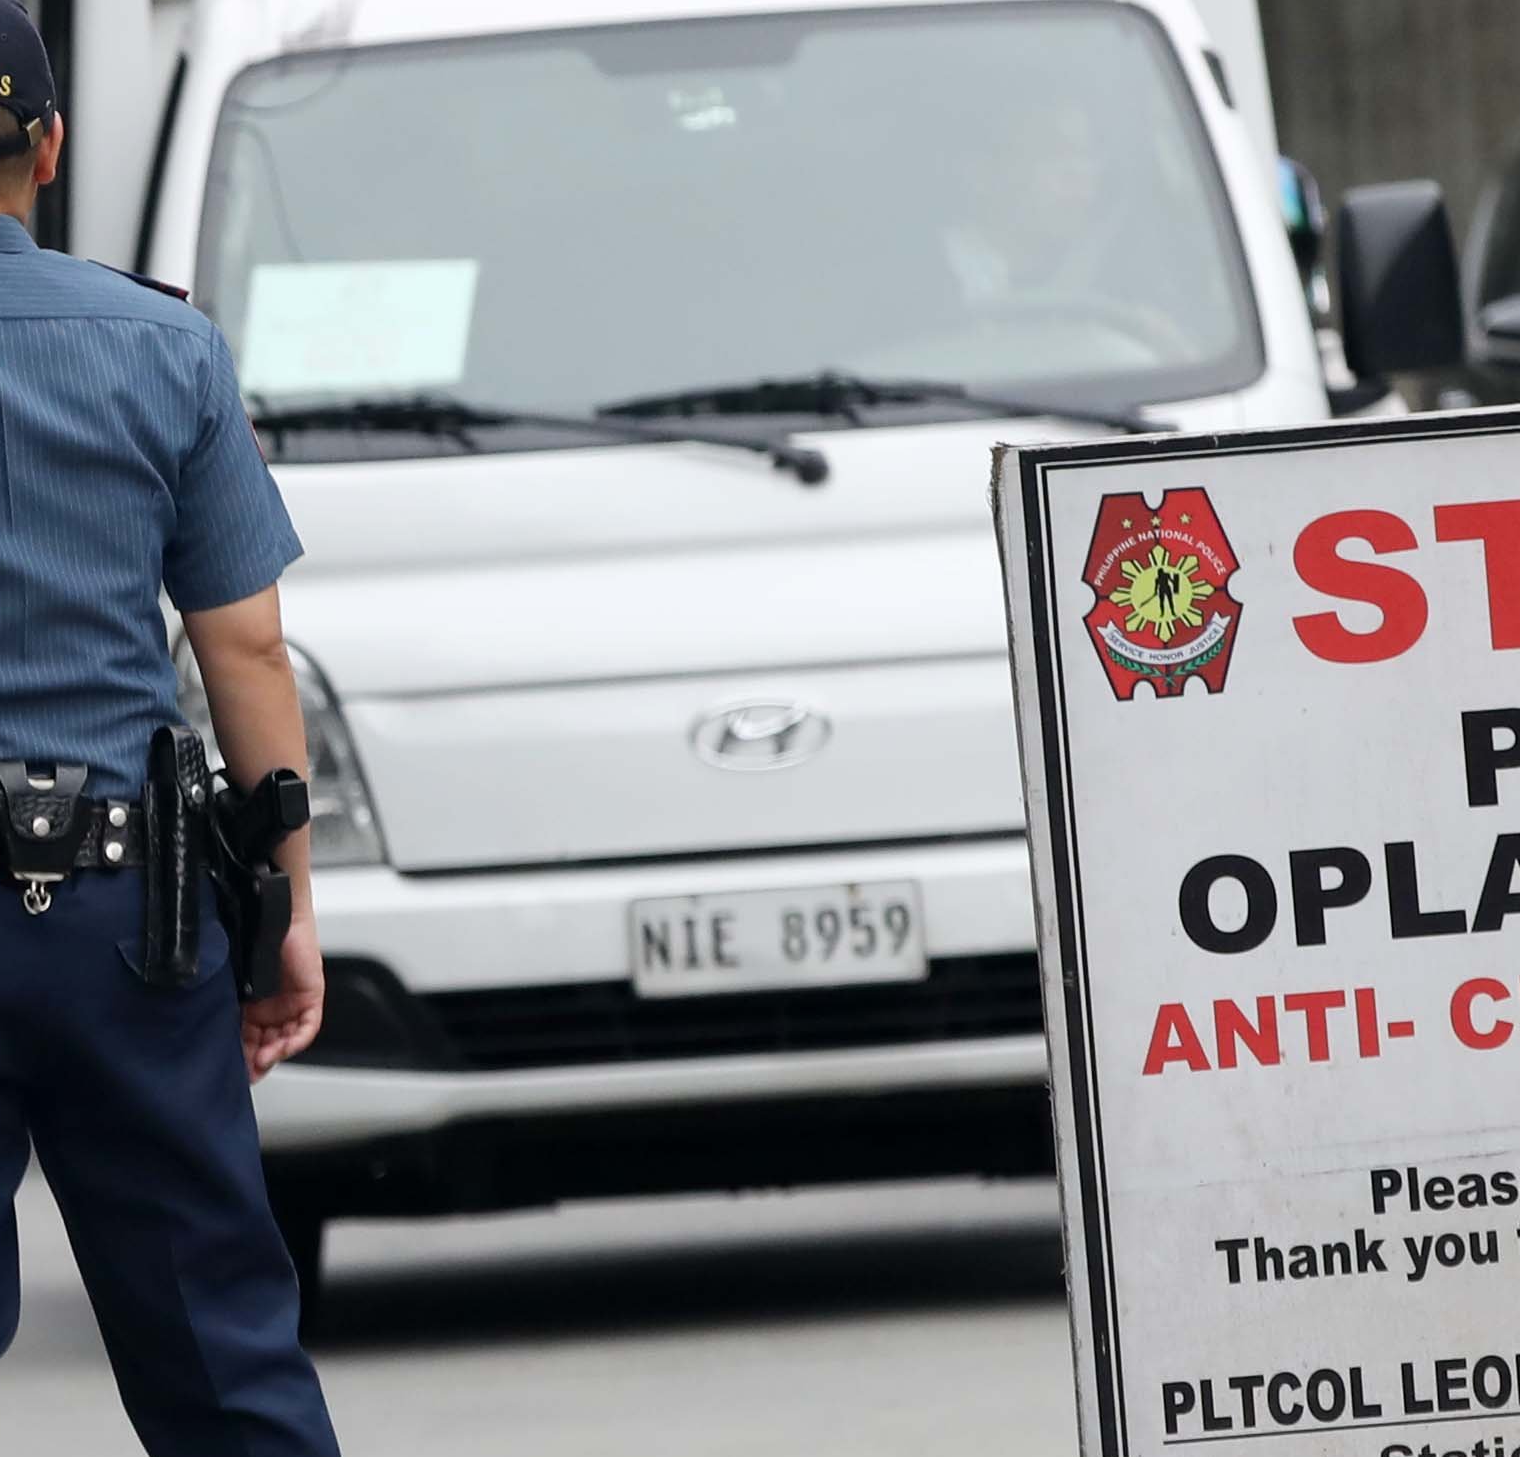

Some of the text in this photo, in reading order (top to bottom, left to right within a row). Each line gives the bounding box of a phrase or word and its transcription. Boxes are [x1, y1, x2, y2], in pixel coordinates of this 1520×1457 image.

[1093, 528, 1227, 587] PHILIPPINE NATIONAL POLICE
[1109, 627, 1221, 662] SERVICE HONOR JUSTICE
[641, 903, 912, 972] NIE 8959
[1143, 988, 1414, 1075] ANTI-
[1215, 1229, 1387, 1284] Thank
[1403, 1231, 1498, 1282] you
[1162, 1367, 1382, 1434] PLTCOL
